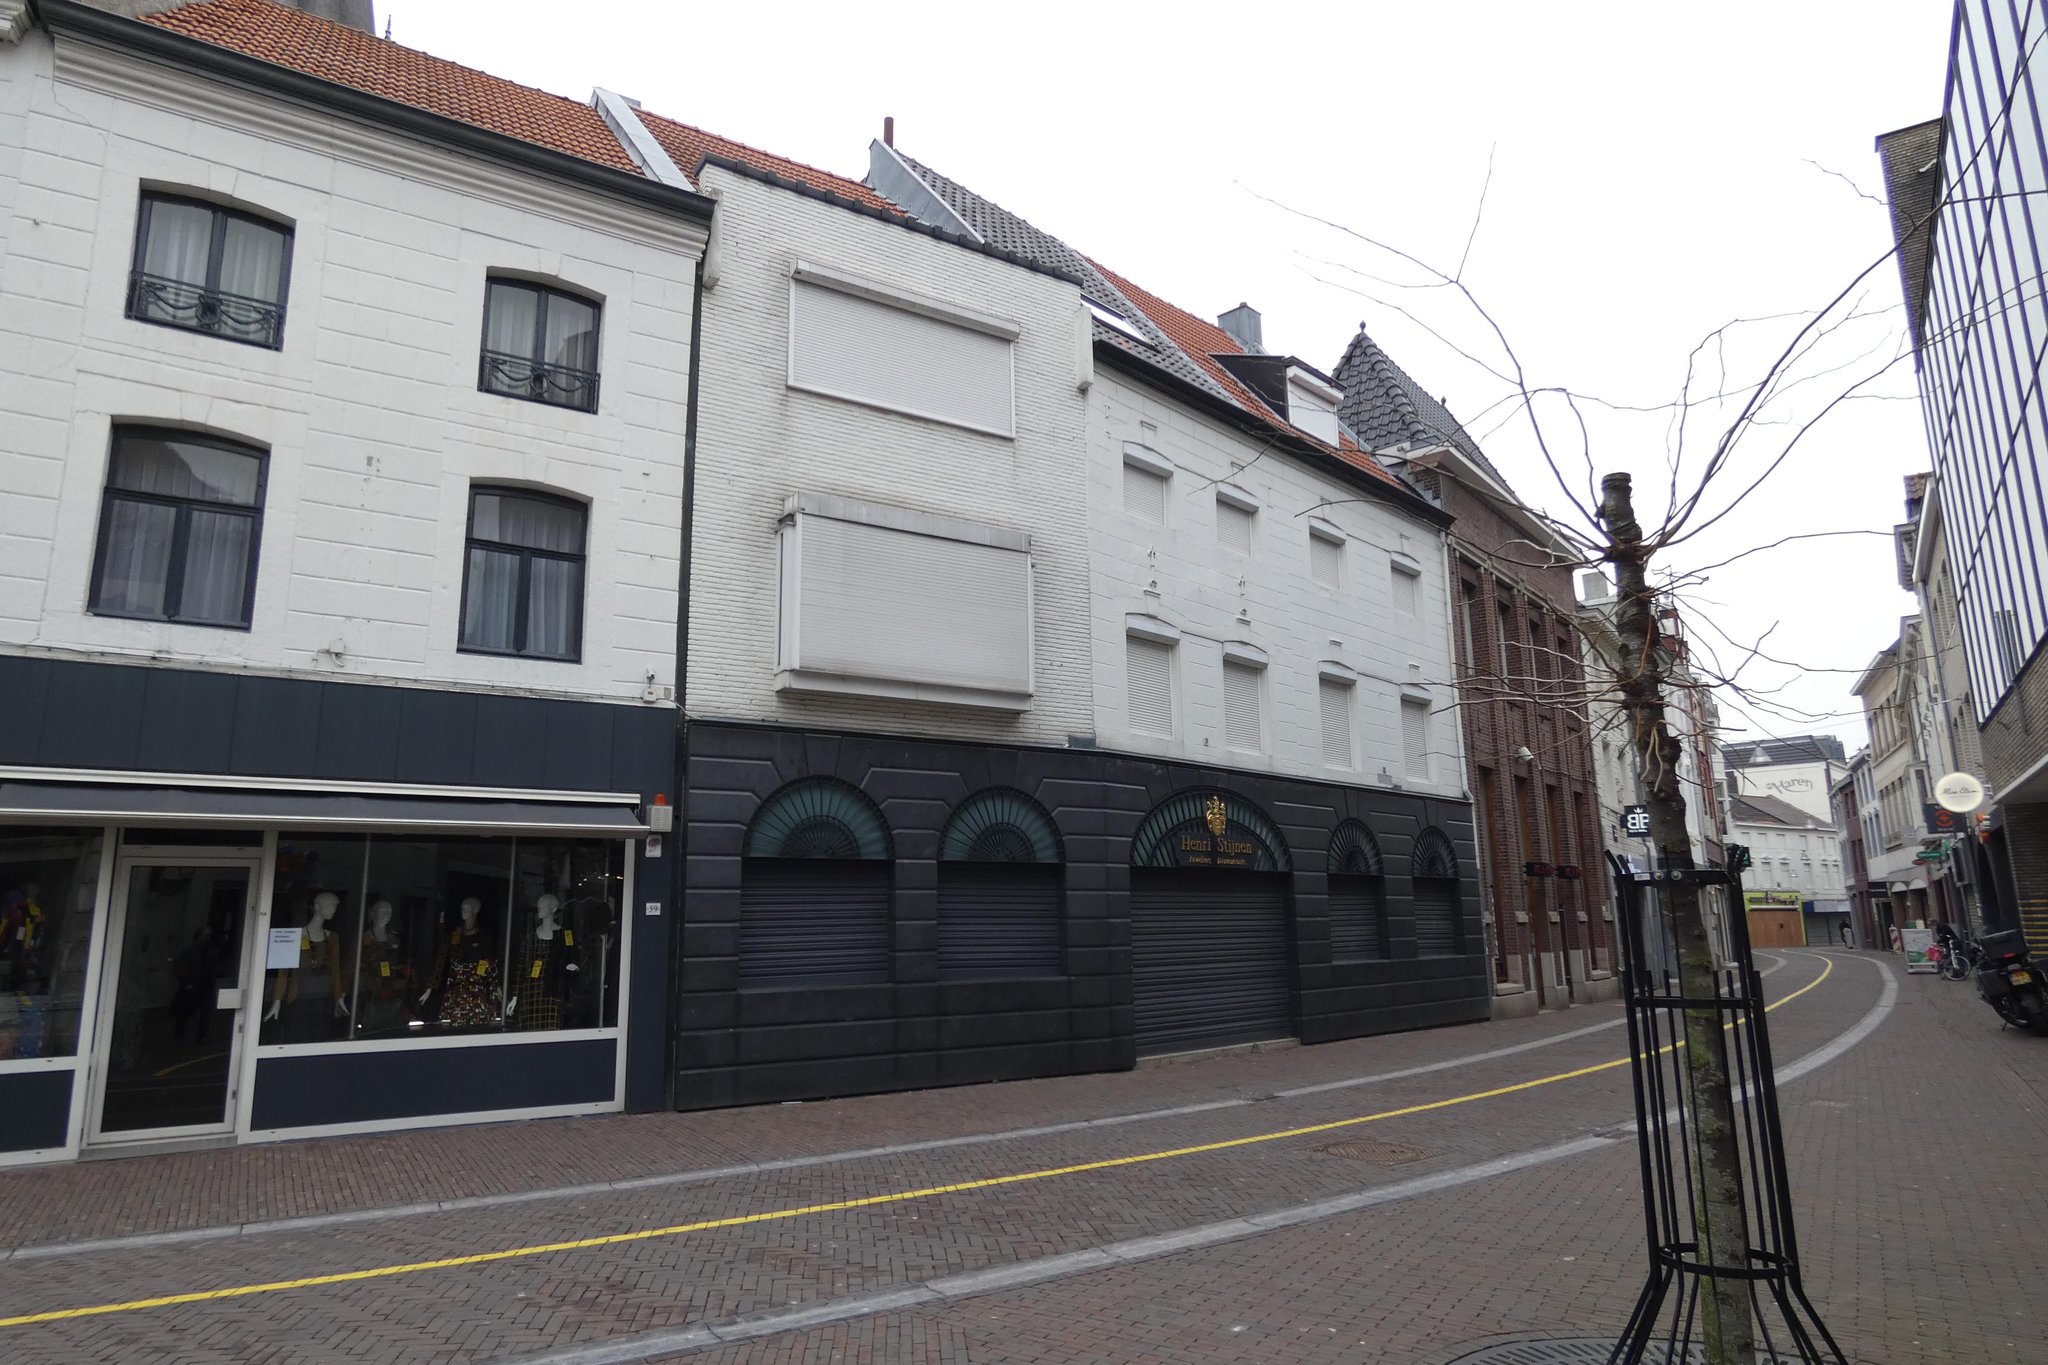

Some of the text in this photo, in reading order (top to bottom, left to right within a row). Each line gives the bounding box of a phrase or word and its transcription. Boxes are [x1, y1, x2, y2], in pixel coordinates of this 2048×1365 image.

[1181, 835, 1253, 856] Henri Stijnen
[648, 905, 659, 913] 59
